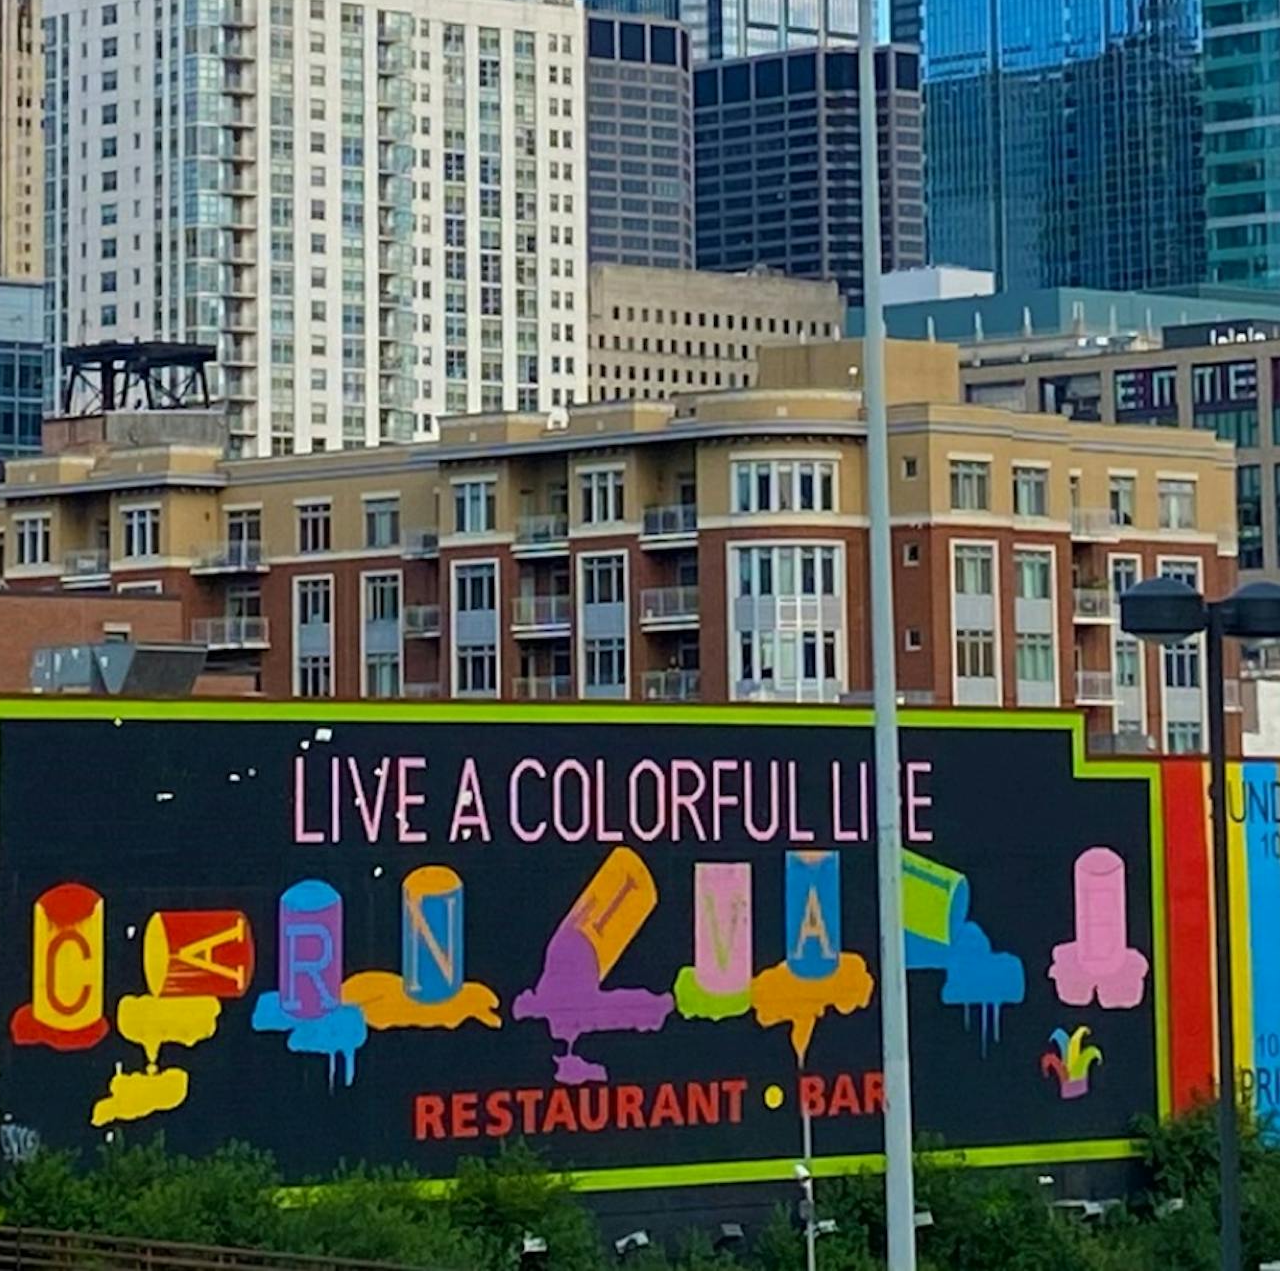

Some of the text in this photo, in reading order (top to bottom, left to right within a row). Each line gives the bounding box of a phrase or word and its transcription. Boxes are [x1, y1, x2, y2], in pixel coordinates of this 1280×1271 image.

[294, 756, 934, 844] LIVE A COLORFUL LIE
[1258, 1032, 1279, 1058] 10
[413, 1071, 888, 1141] RESTAURANT BAR
